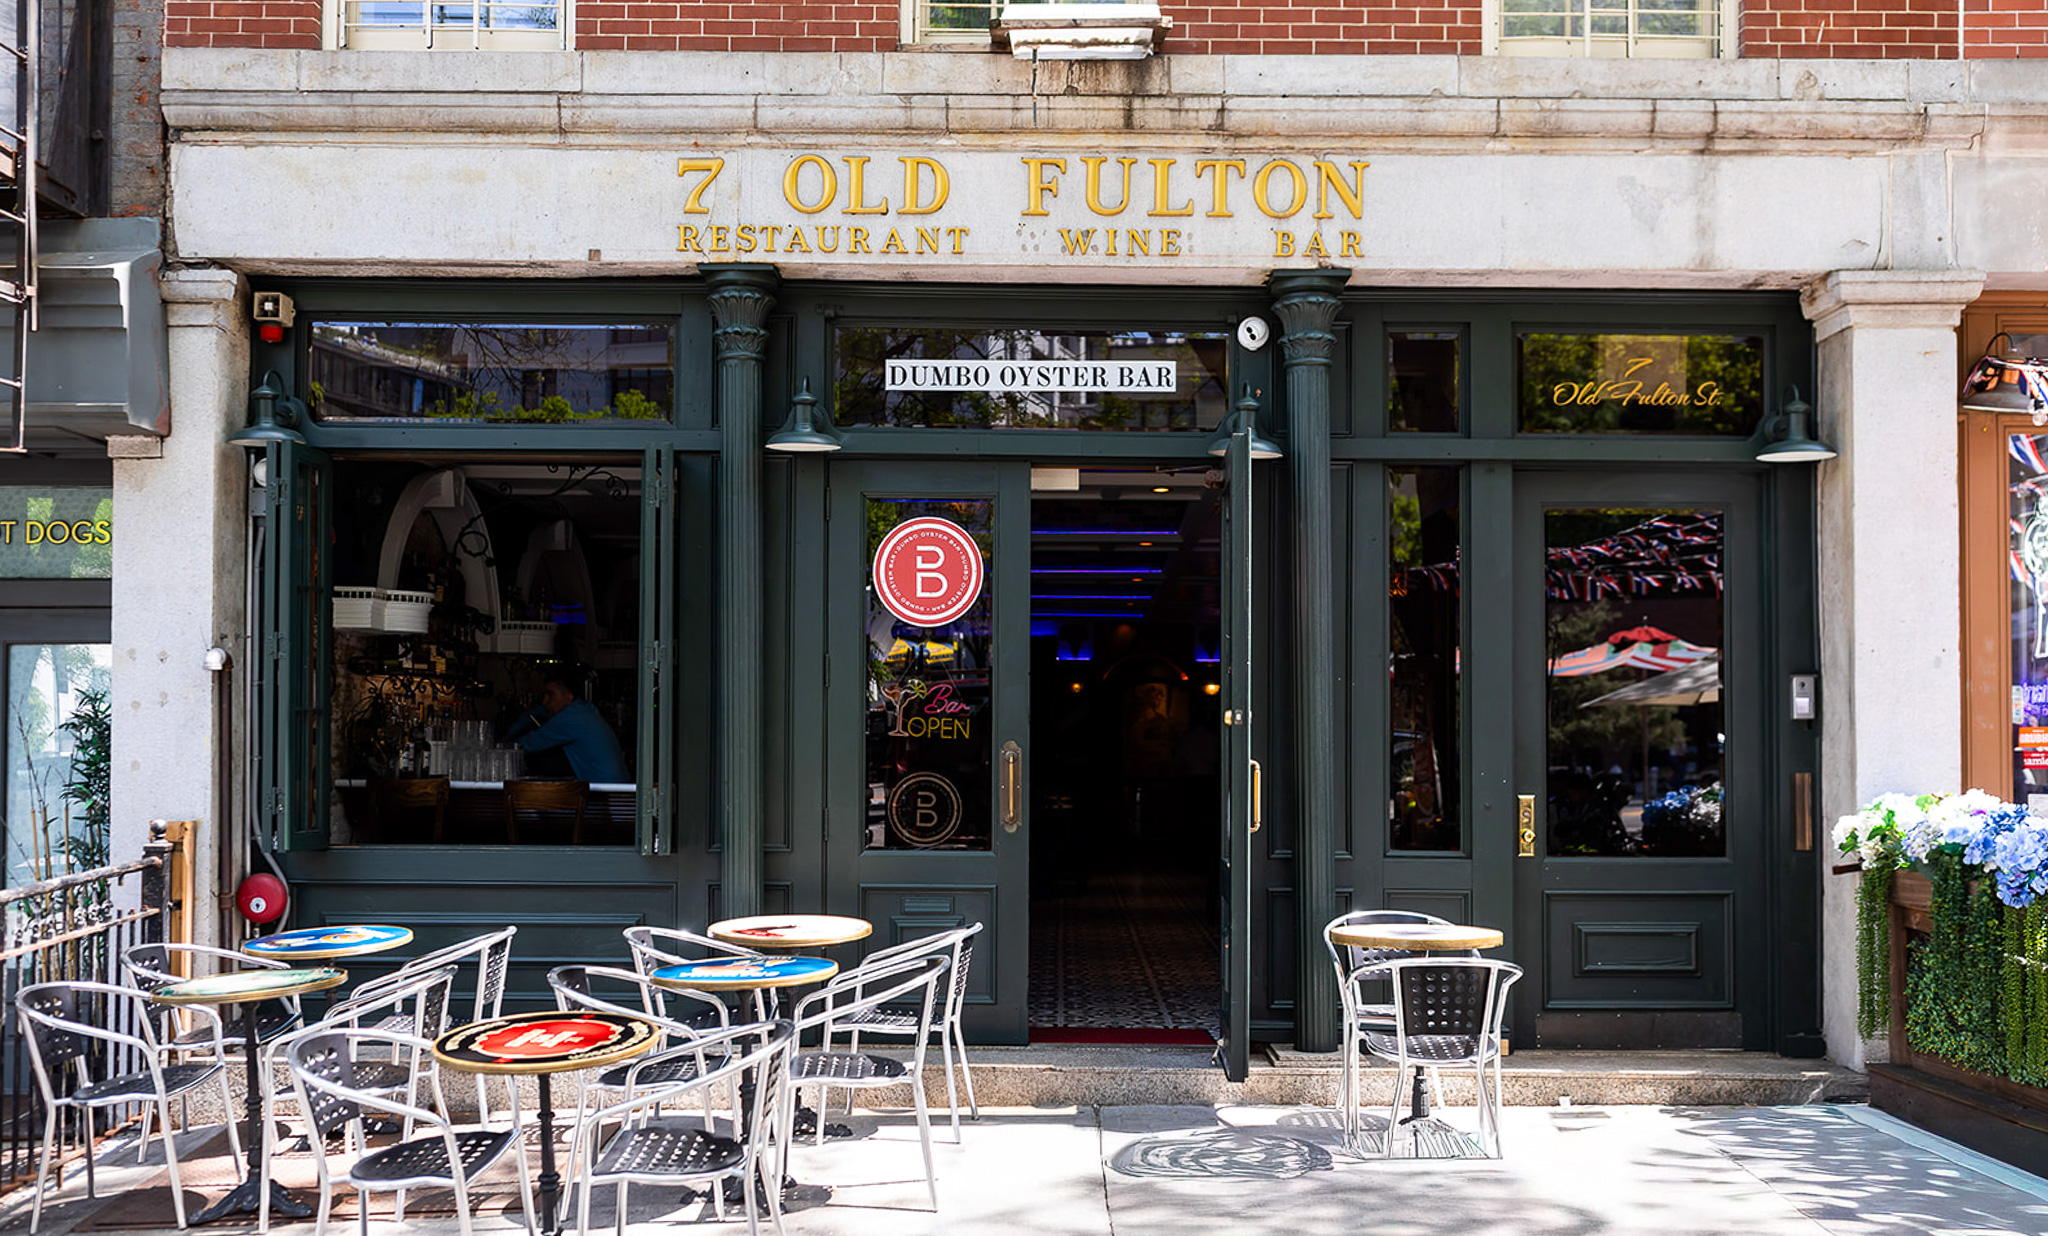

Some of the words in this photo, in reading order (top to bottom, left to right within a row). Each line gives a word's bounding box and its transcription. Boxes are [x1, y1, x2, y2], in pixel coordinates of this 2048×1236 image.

[677, 156, 725, 215] 7
[782, 153, 950, 216] OLD
[1020, 156, 1371, 220] FULTON
[676, 223, 970, 255] RESTAURANT
[1057, 228, 1182, 257] WINE
[1272, 229, 1365, 259] BAR
[889, 364, 991, 387] DUMBO
[1000, 365, 1110, 387] OYSTER
[1117, 366, 1174, 388] BAR
[1624, 357, 1654, 378] 7
[1552, 380, 1614, 407] Old
[1607, 380, 1691, 407] Fulton
[1694, 380, 1725, 406] St.
[0, 520, 18, 544] T
[25, 519, 112, 544] DOGS
[896, 534, 918, 551] DUMBO
[920, 532, 948, 540] OYSTER
[924, 684, 970, 714] Bar
[907, 716, 970, 739] OPEN
